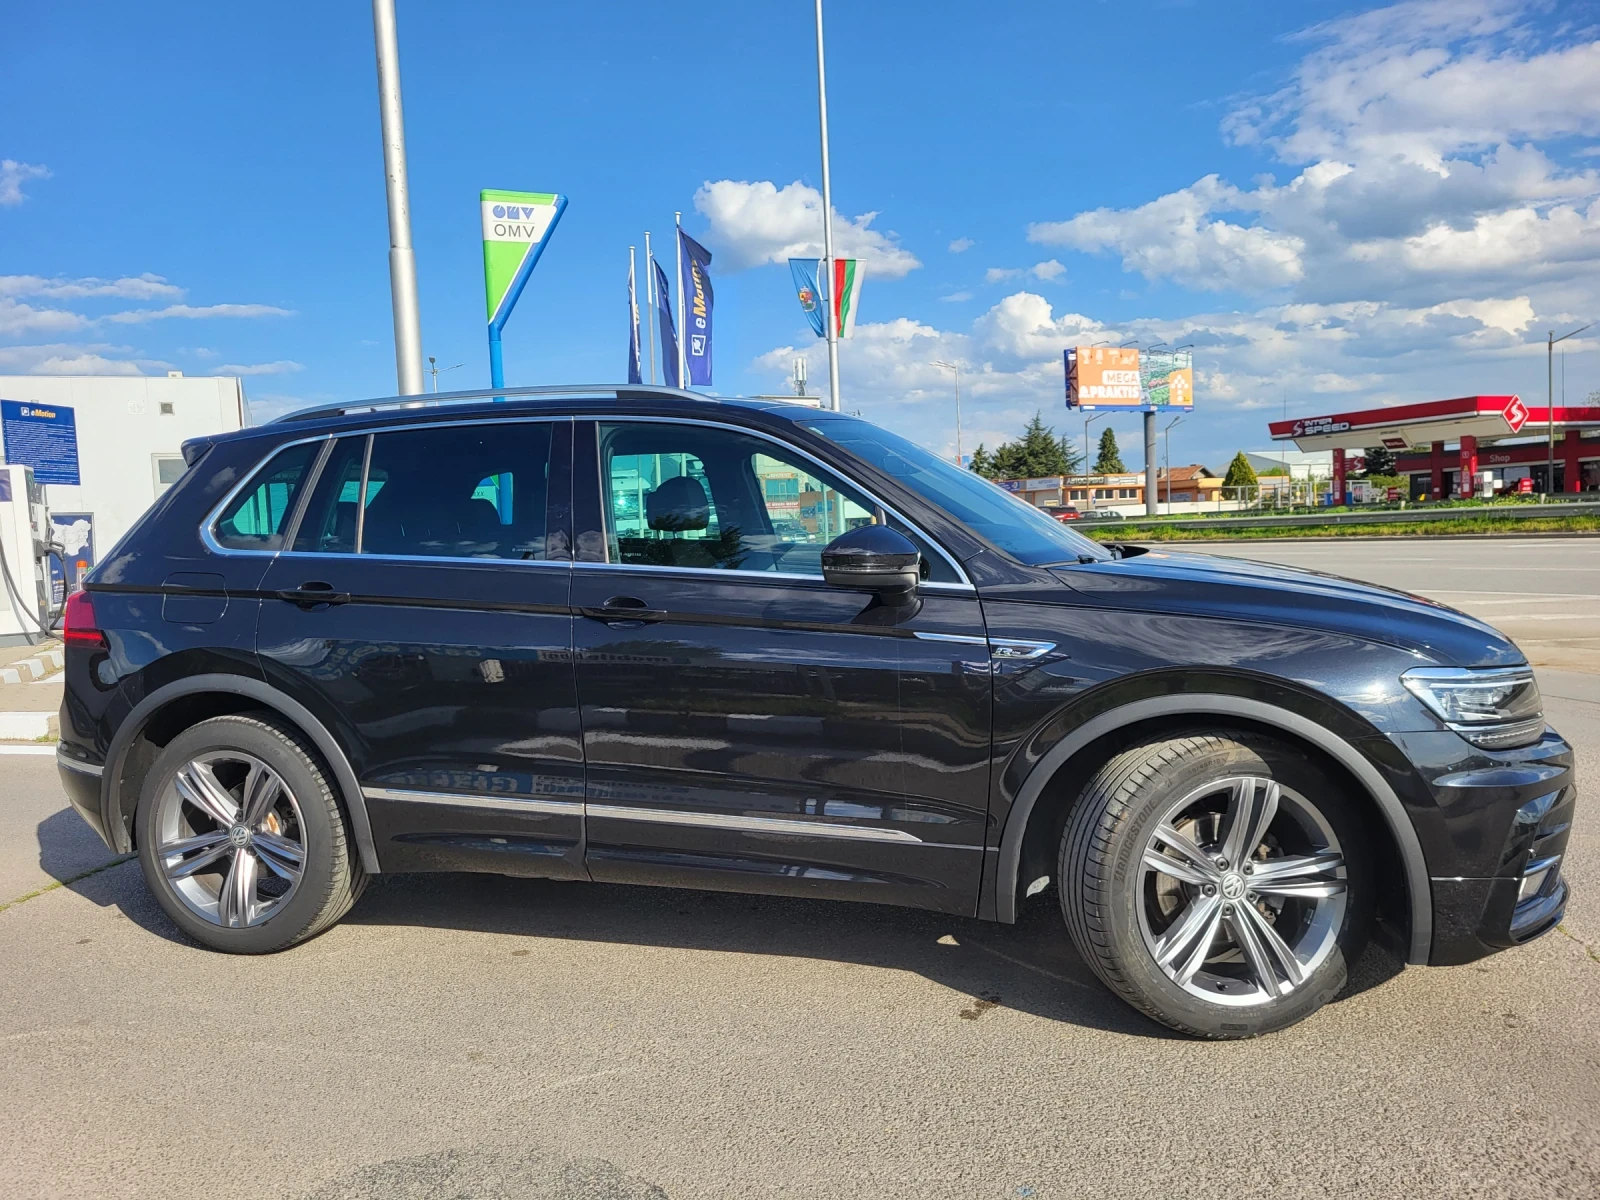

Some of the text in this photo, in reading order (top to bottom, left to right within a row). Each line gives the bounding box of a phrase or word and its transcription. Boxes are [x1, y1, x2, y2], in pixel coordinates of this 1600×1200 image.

[494, 223, 535, 238] OMV
[1107, 373, 1137, 383] MEGA
[30, 409, 56, 418] eMotion
[1304, 418, 1332, 426] INTER
[1305, 422, 1350, 435] SPEED
[1489, 454, 1511, 463] Shop
[1113, 799, 1158, 884] BRIDGESTONE
